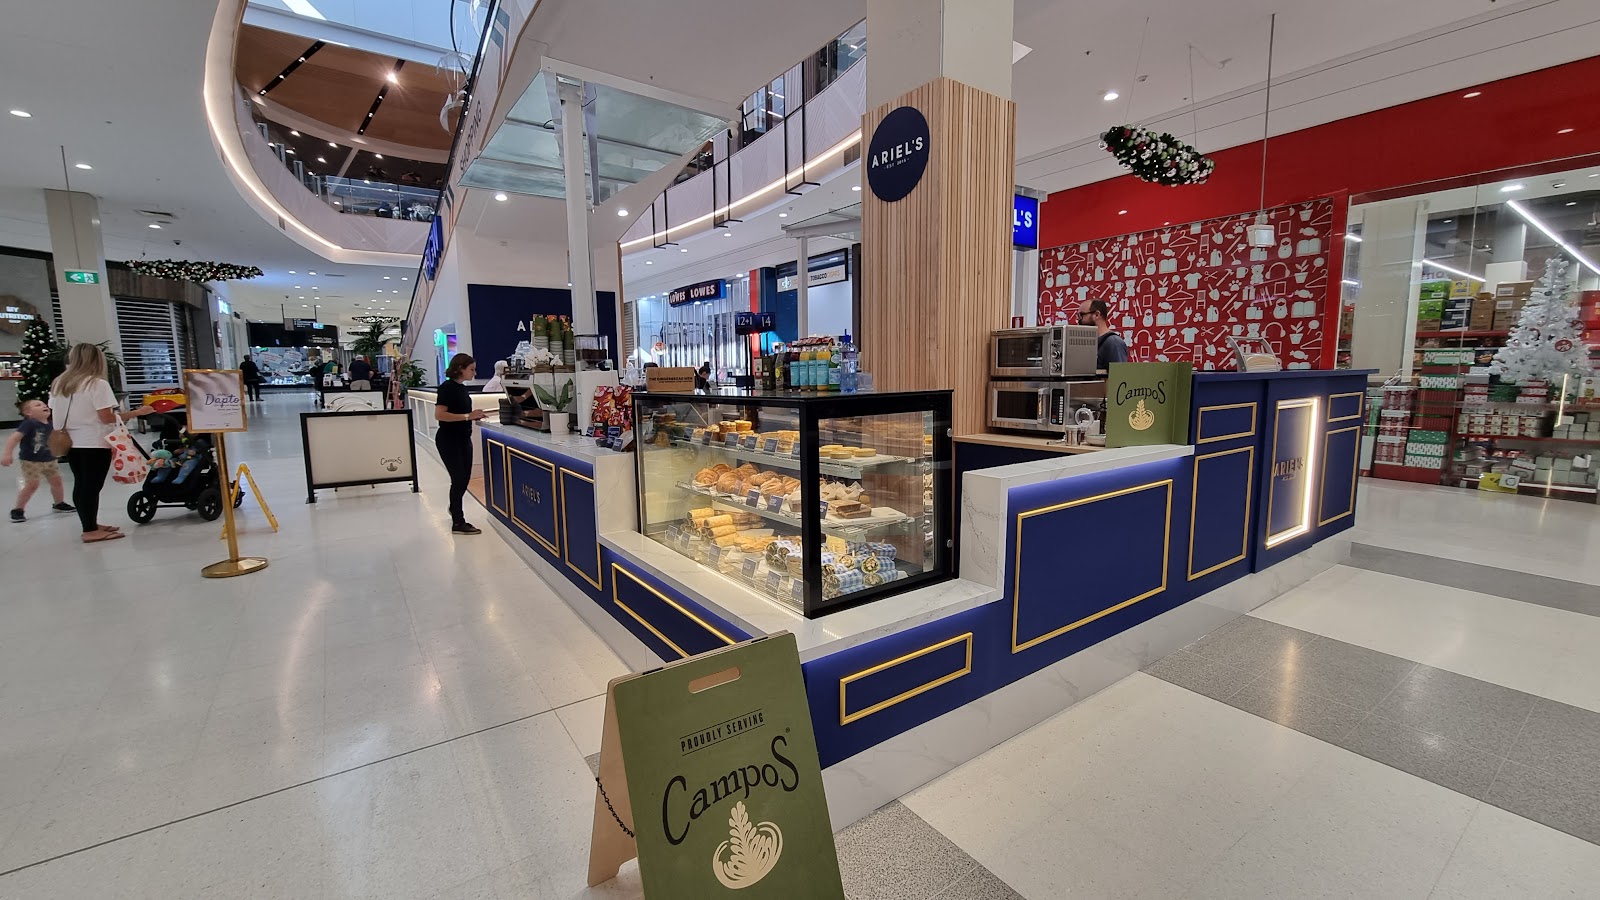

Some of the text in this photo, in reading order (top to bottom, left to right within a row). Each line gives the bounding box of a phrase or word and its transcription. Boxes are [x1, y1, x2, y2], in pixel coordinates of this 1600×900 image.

[871, 136, 923, 169] ARIEL'S
[669, 291, 686, 304] LOWES
[690, 284, 716, 299] LOWES
[204, 393, 240, 409] Dapto
[680, 712, 764, 753] PROUDLY SERVING
